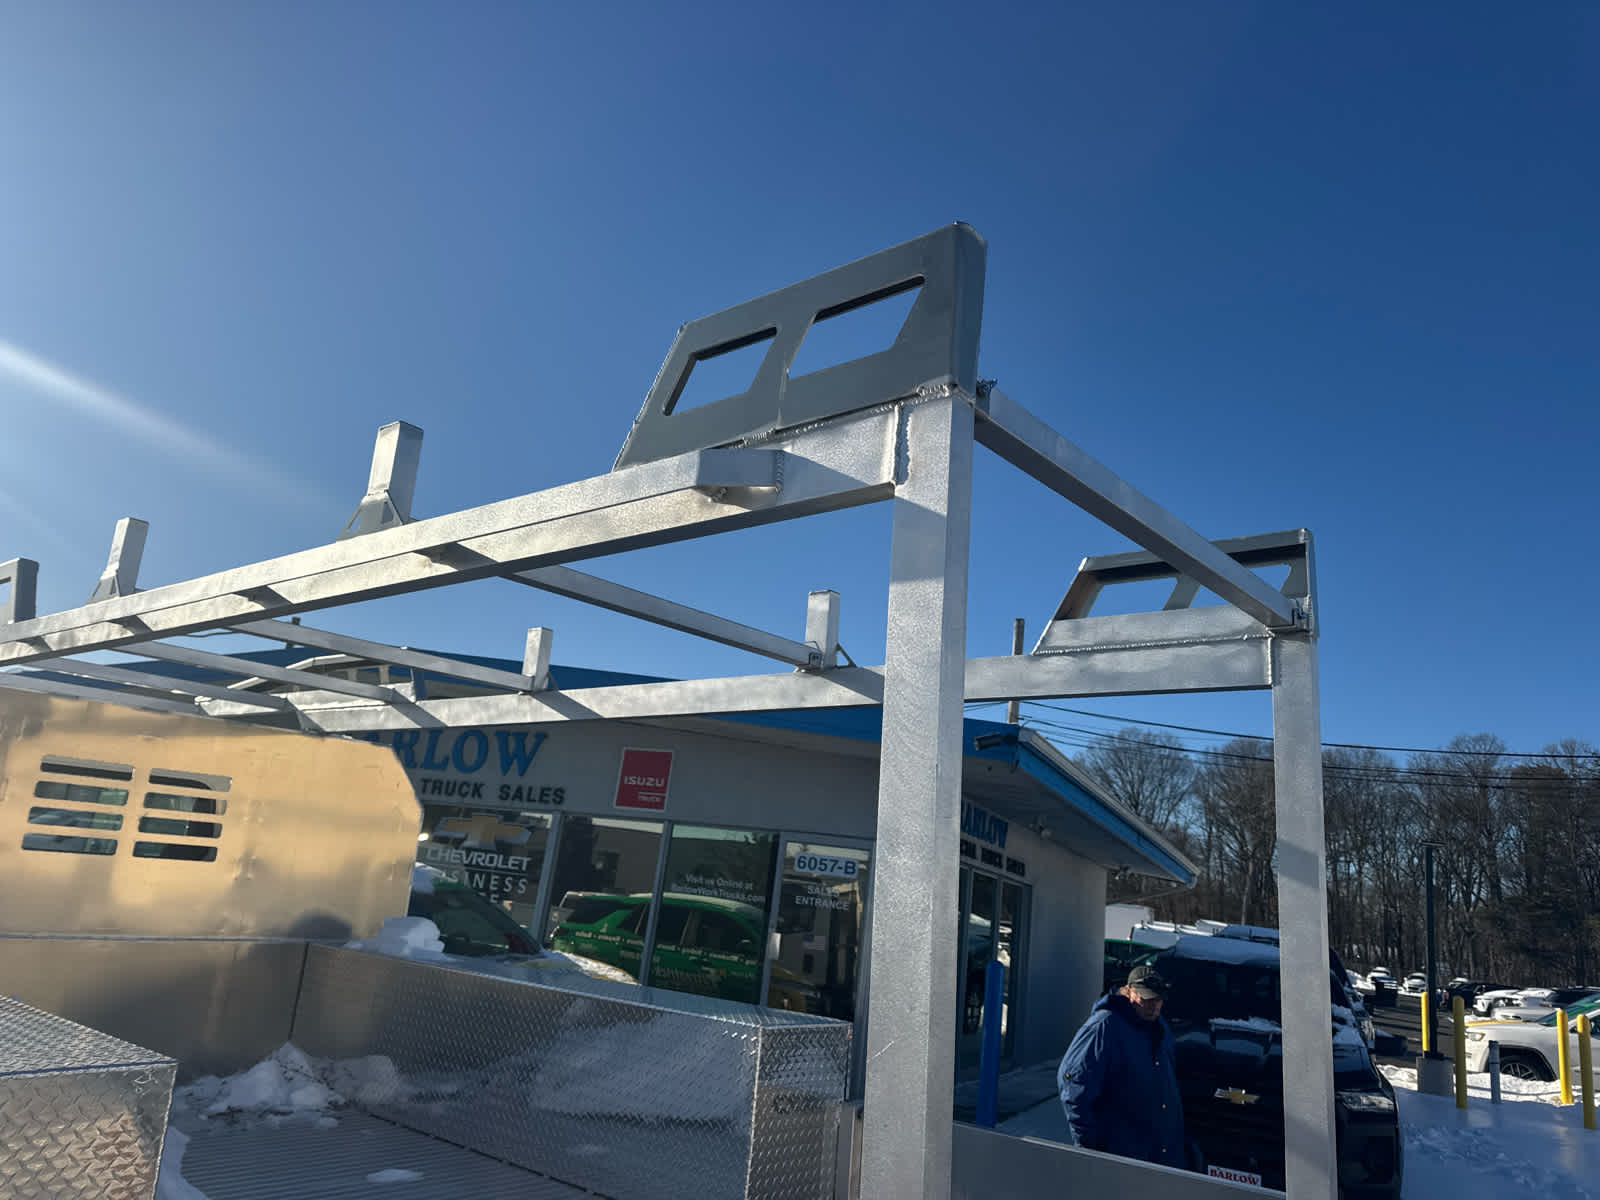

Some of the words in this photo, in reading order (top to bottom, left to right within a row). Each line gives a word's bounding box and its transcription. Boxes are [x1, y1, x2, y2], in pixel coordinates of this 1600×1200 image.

[365, 729, 547, 776] RLOW
[421, 778, 485, 798] TRUCK
[498, 784, 566, 805] SALES
[623, 776, 665, 787] ISUZU
[961, 800, 1008, 848] ARLOW
[426, 847, 532, 871] CHEVROLET
[797, 855, 856, 875] 6057-B
[441, 868, 528, 894] SINESS
[807, 884, 840, 897] SALES
[795, 895, 849, 911] ENTRANCE
[1209, 1168, 1258, 1184] BARLOW
